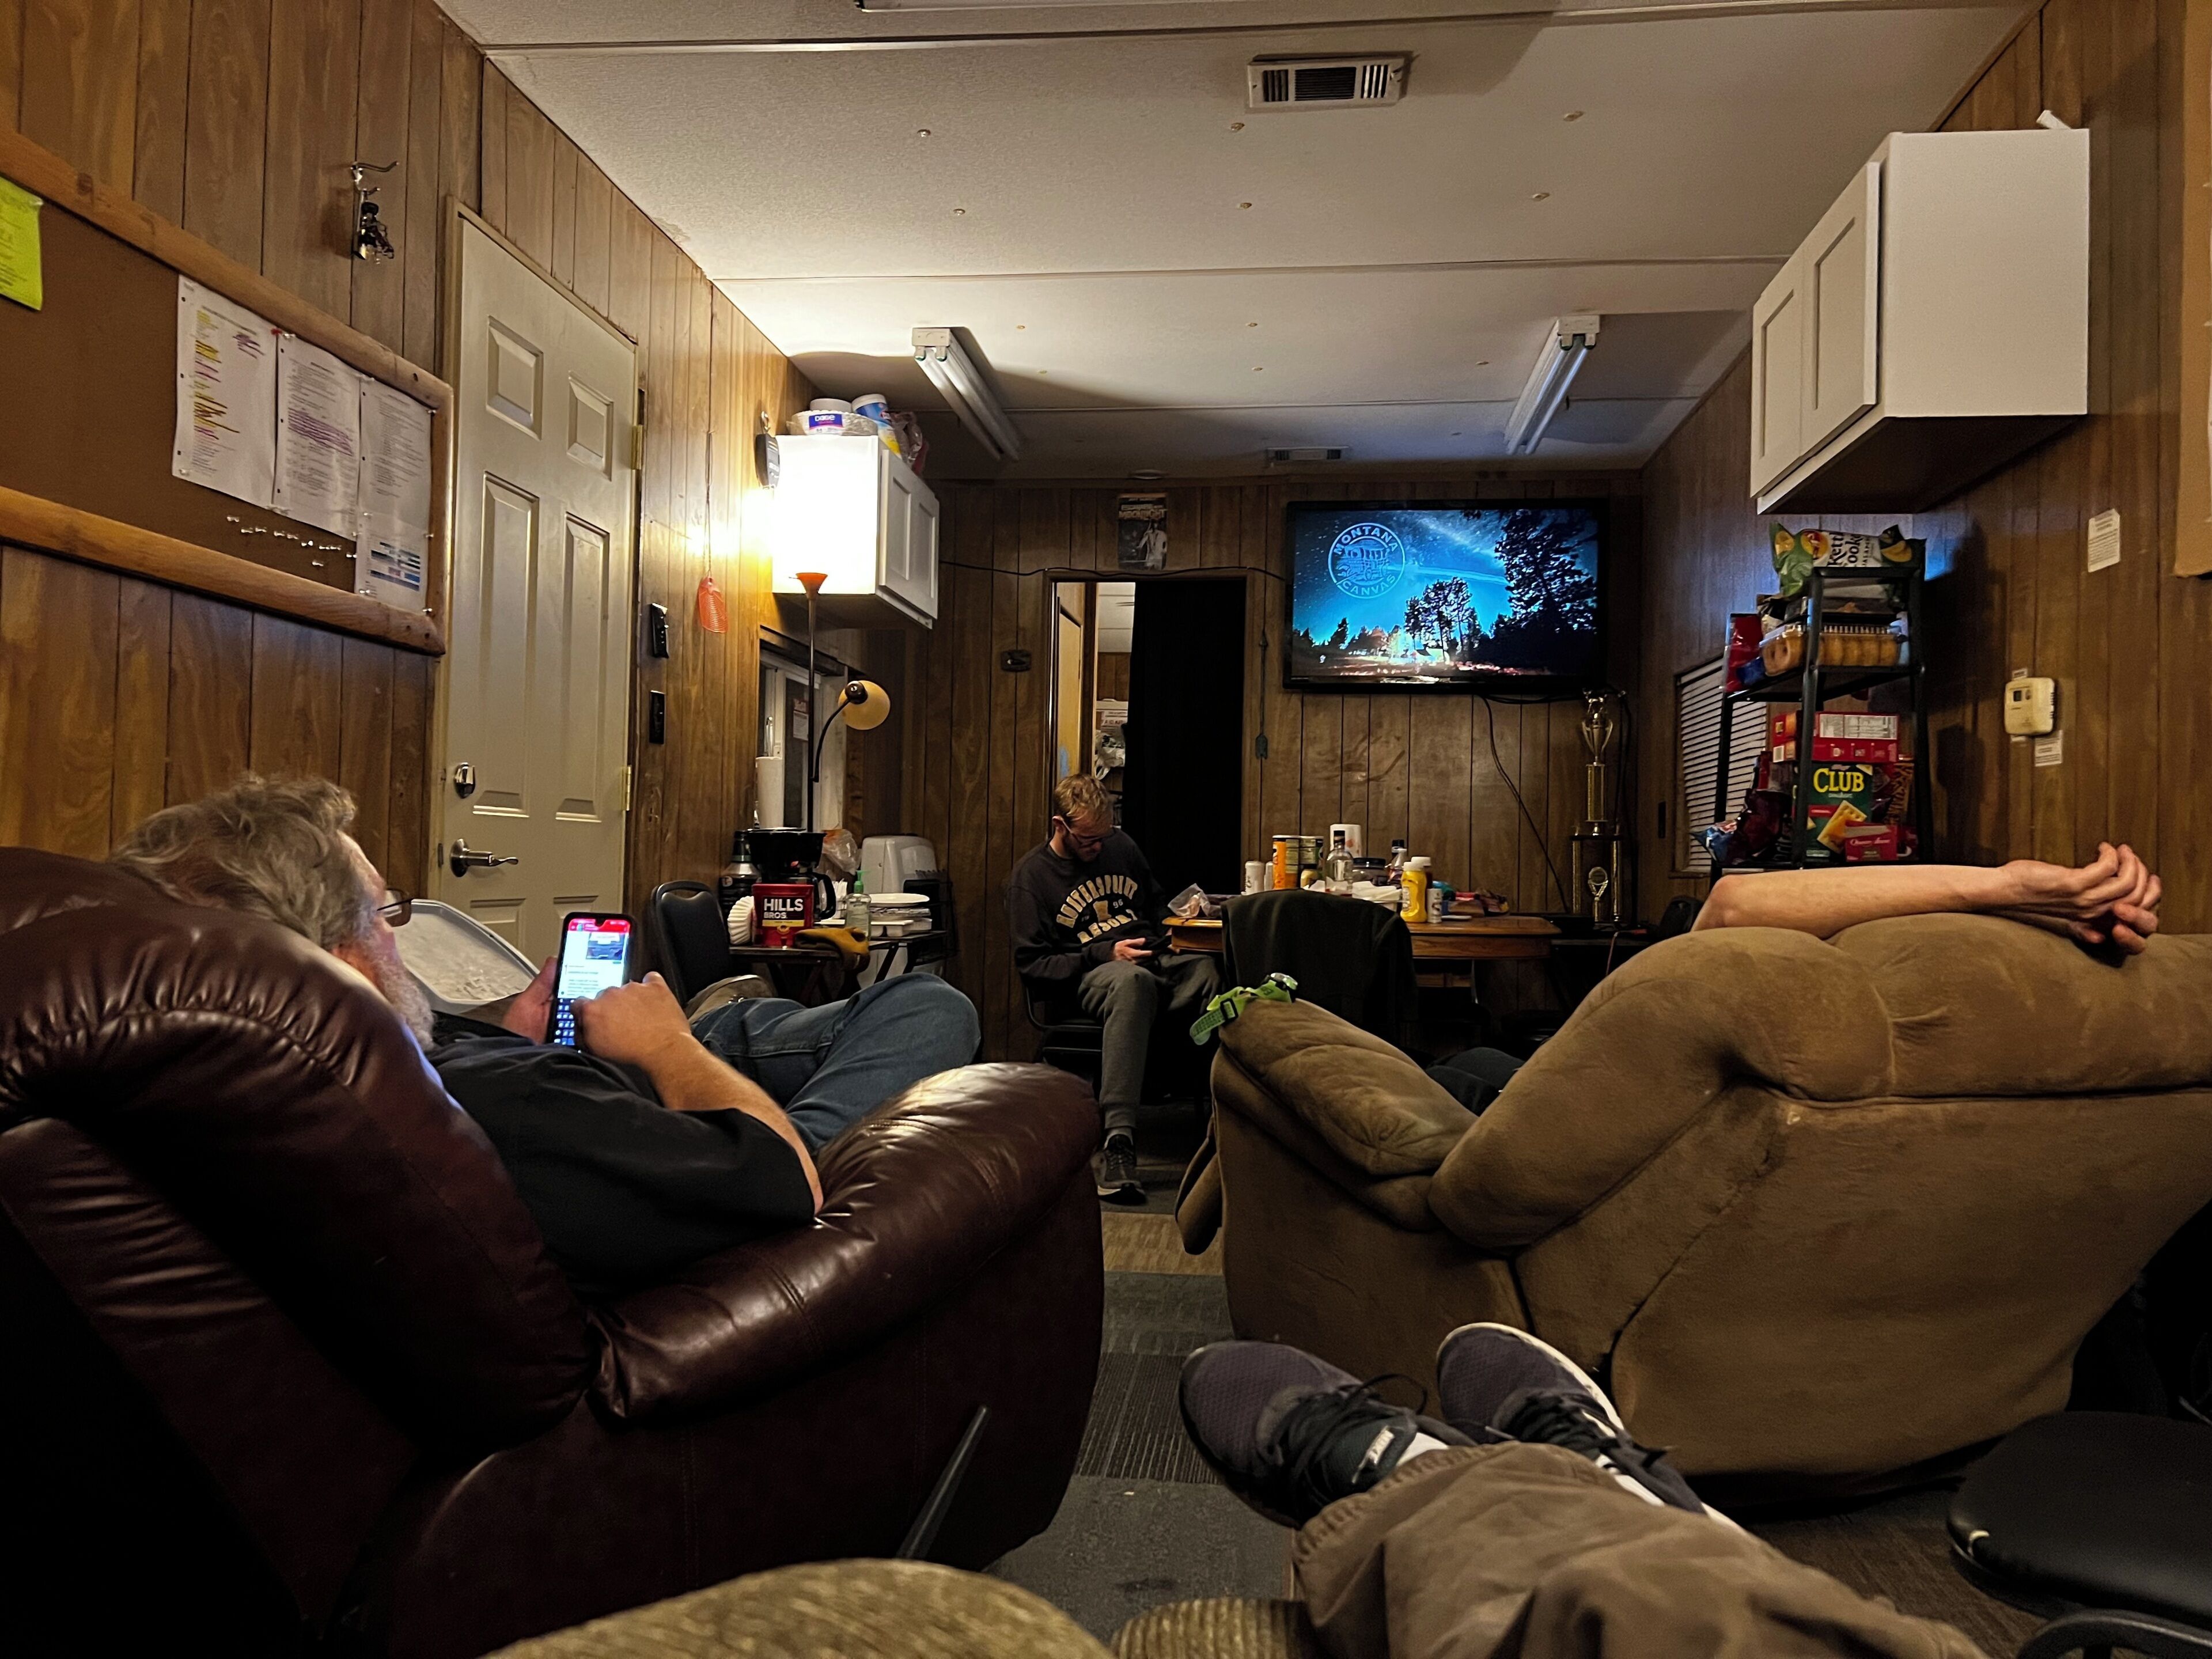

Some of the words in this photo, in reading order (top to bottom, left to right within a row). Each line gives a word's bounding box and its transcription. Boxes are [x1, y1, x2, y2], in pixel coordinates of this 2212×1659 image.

[1334, 526, 1398, 555] MONTANA
[1827, 532, 1847, 567] Kettl
[1342, 574, 1396, 595] CANVAS
[1813, 768, 1865, 793] CLUB
[764, 898, 804, 911] HILLS
